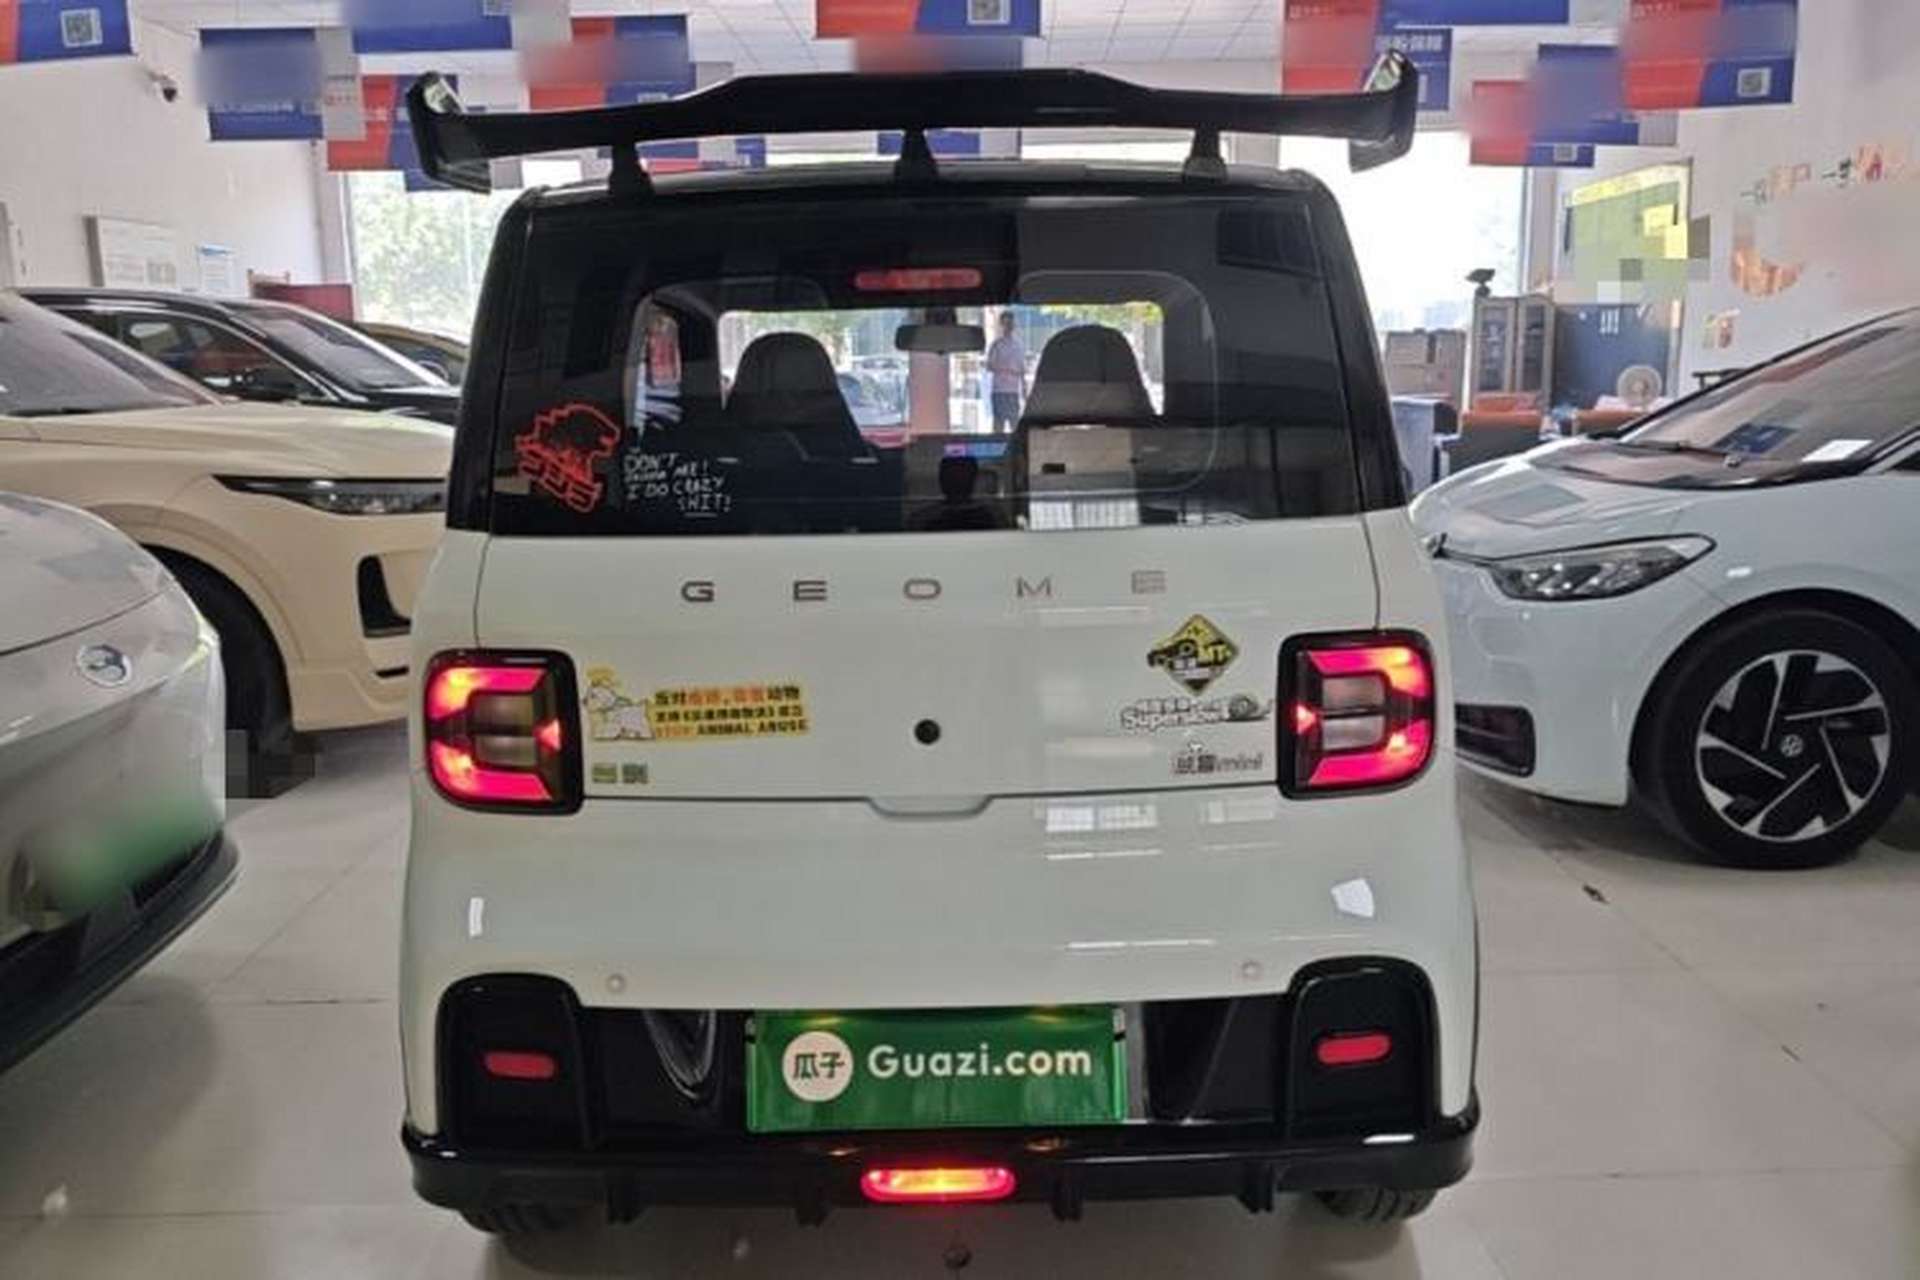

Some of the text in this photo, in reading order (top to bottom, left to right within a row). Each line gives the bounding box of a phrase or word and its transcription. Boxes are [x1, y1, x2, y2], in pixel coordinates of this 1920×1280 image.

[681, 570, 1167, 602] GEOME
[792, 1043, 1092, 1079] 瓜子 Guazi.com
